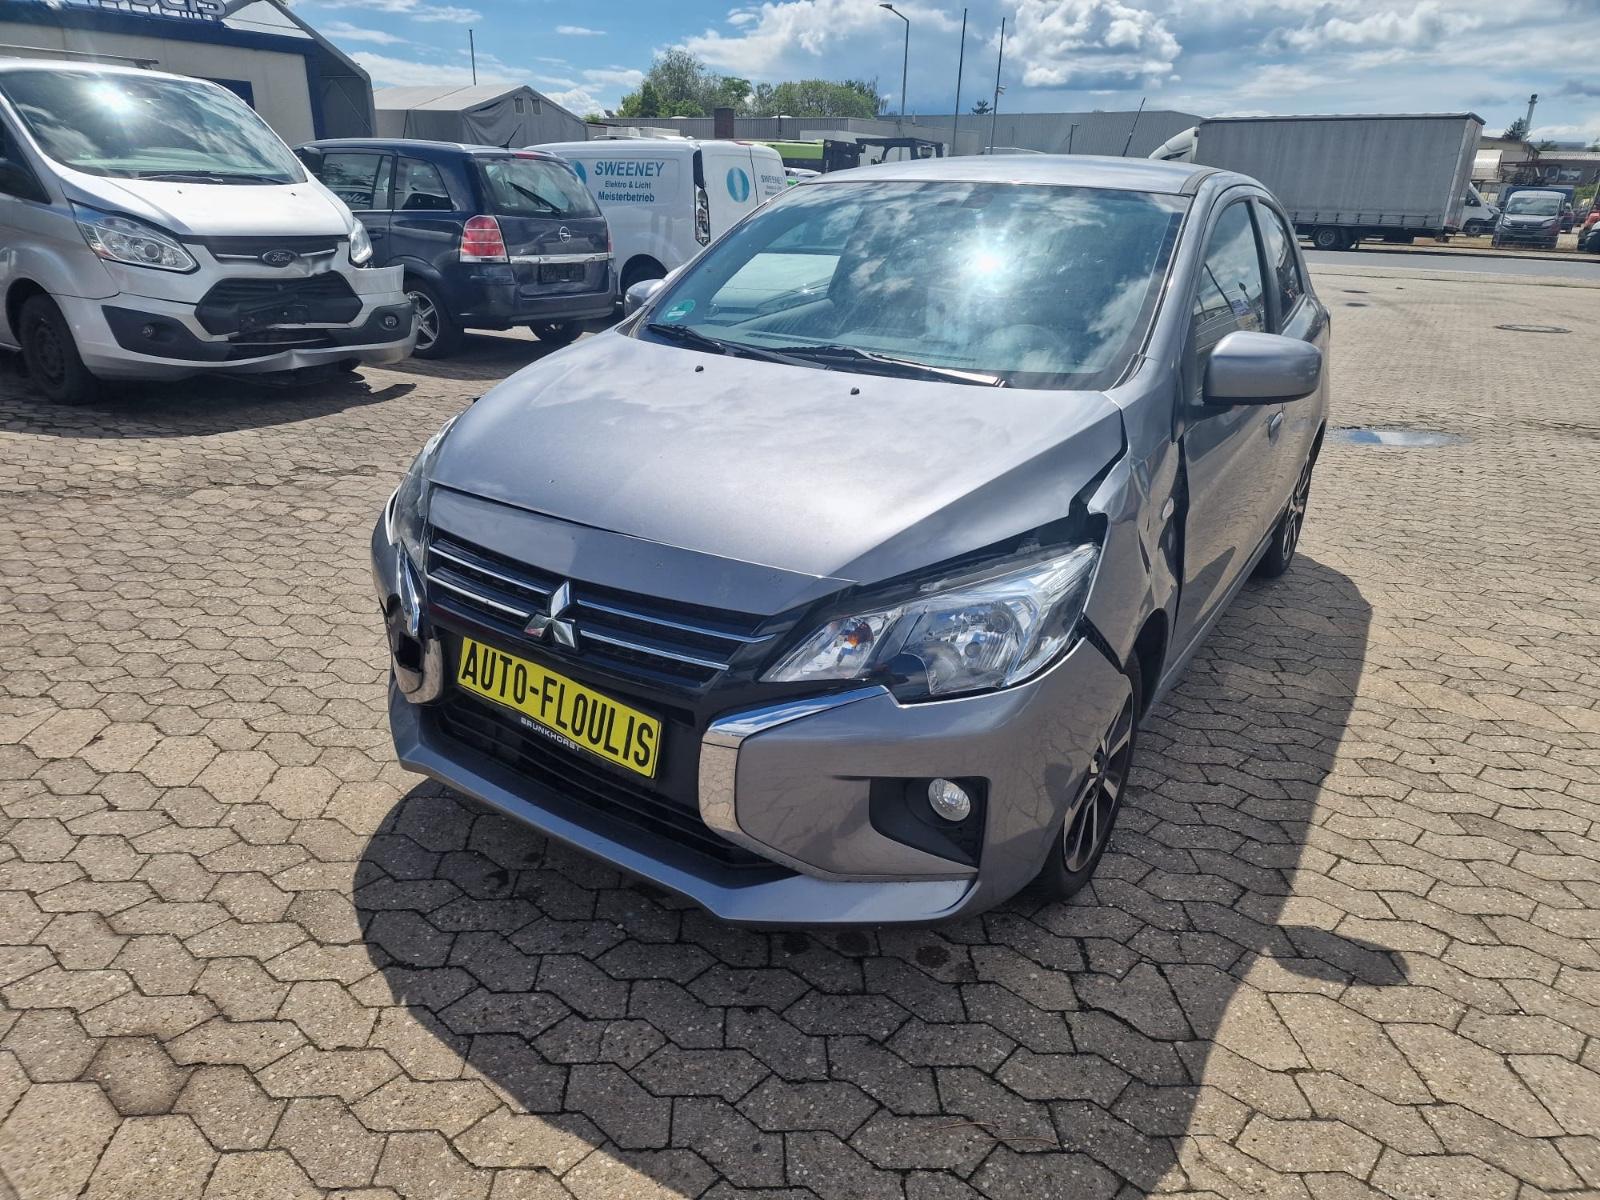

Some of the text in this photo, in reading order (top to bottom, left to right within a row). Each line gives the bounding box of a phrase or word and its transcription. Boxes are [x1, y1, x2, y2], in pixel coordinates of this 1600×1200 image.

[594, 161, 665, 177] SWEENEY
[604, 180, 652, 190] Elektro & Licht
[597, 191, 655, 203] Meisterbetrieb
[461, 641, 654, 768] AUTO-FLOULIS
[520, 716, 581, 752] BRUNKHORST
